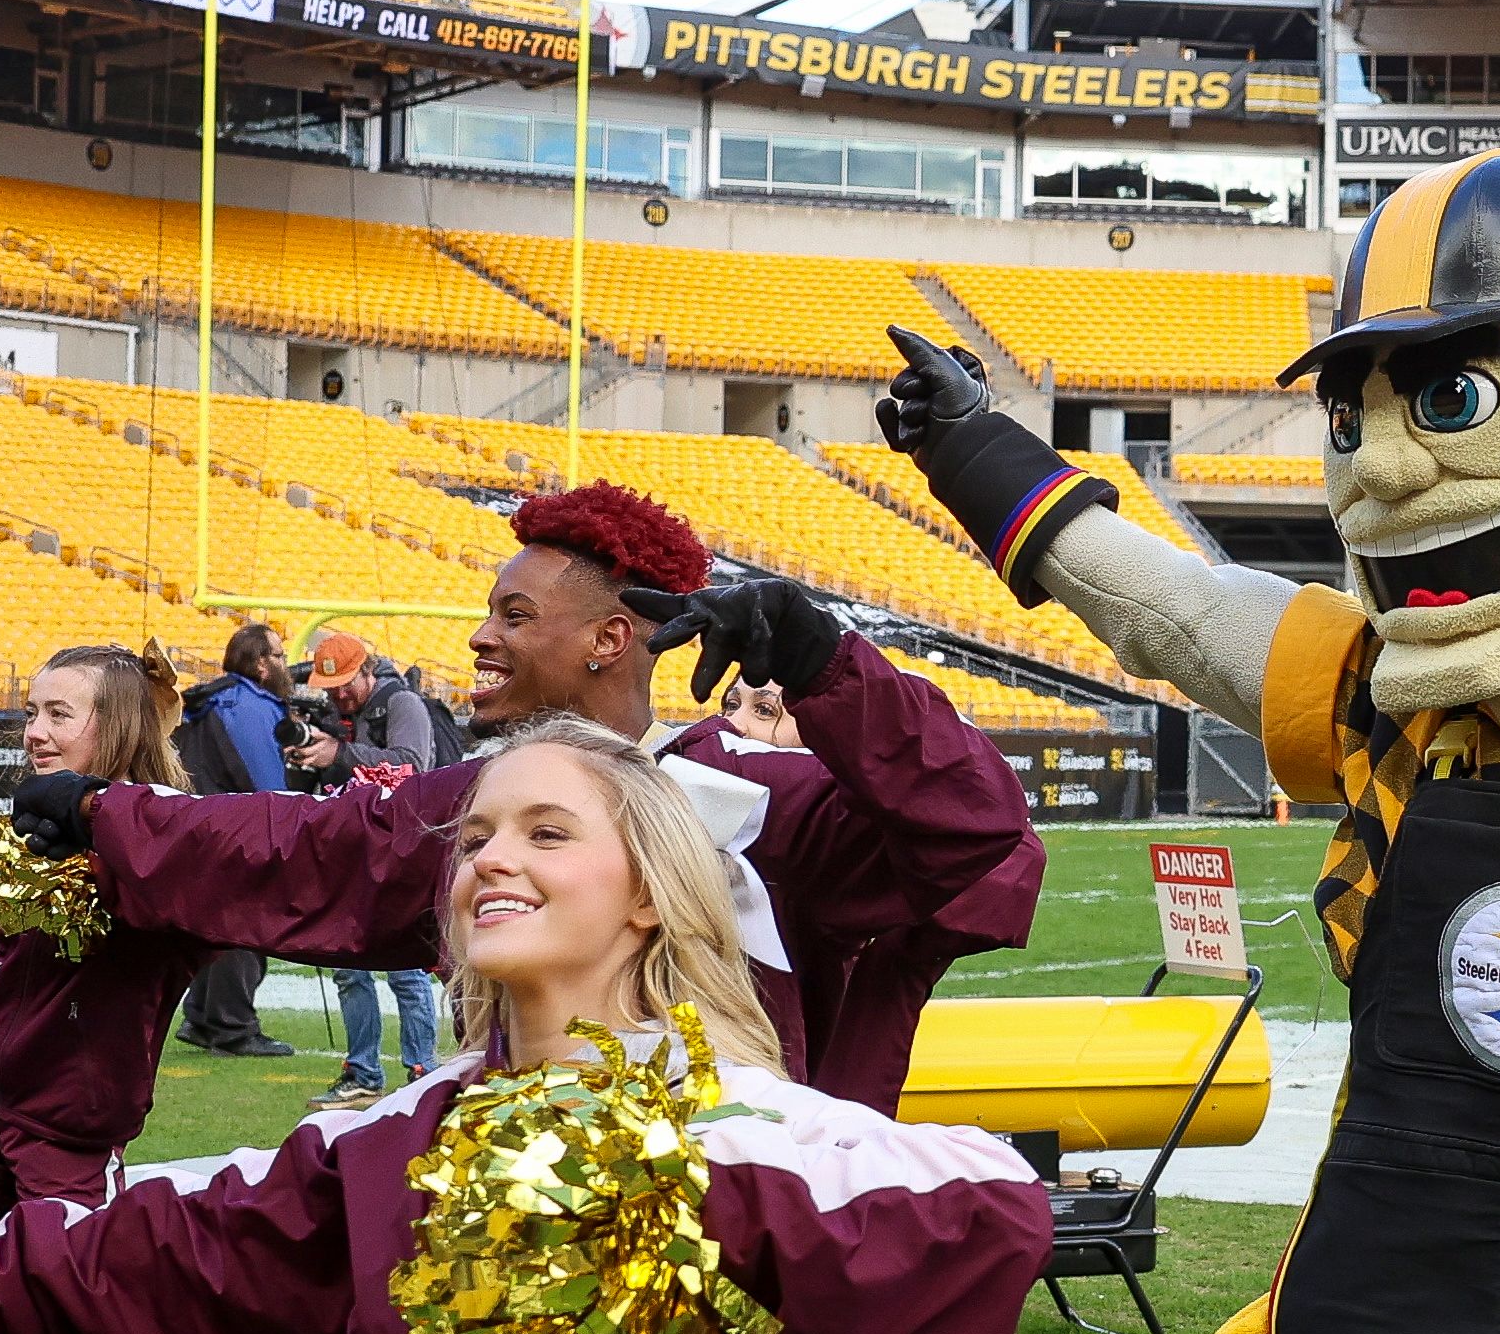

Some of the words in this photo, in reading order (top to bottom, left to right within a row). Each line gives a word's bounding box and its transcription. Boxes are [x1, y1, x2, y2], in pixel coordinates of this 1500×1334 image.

[378, 9, 430, 41] CALL
[663, 20, 970, 95] PITTSBURGH
[980, 58, 1231, 110] STEELERS
[1341, 126, 1448, 156] UPMC
[1158, 850, 1225, 879] DANGER
[1168, 885, 1196, 911] Very
[1199, 888, 1223, 908] Hot
[1169, 911, 1196, 936] Stay
[1199, 914, 1230, 936] Back
[1185, 938, 1193, 958] 4
[1195, 939, 1223, 960] Feet
